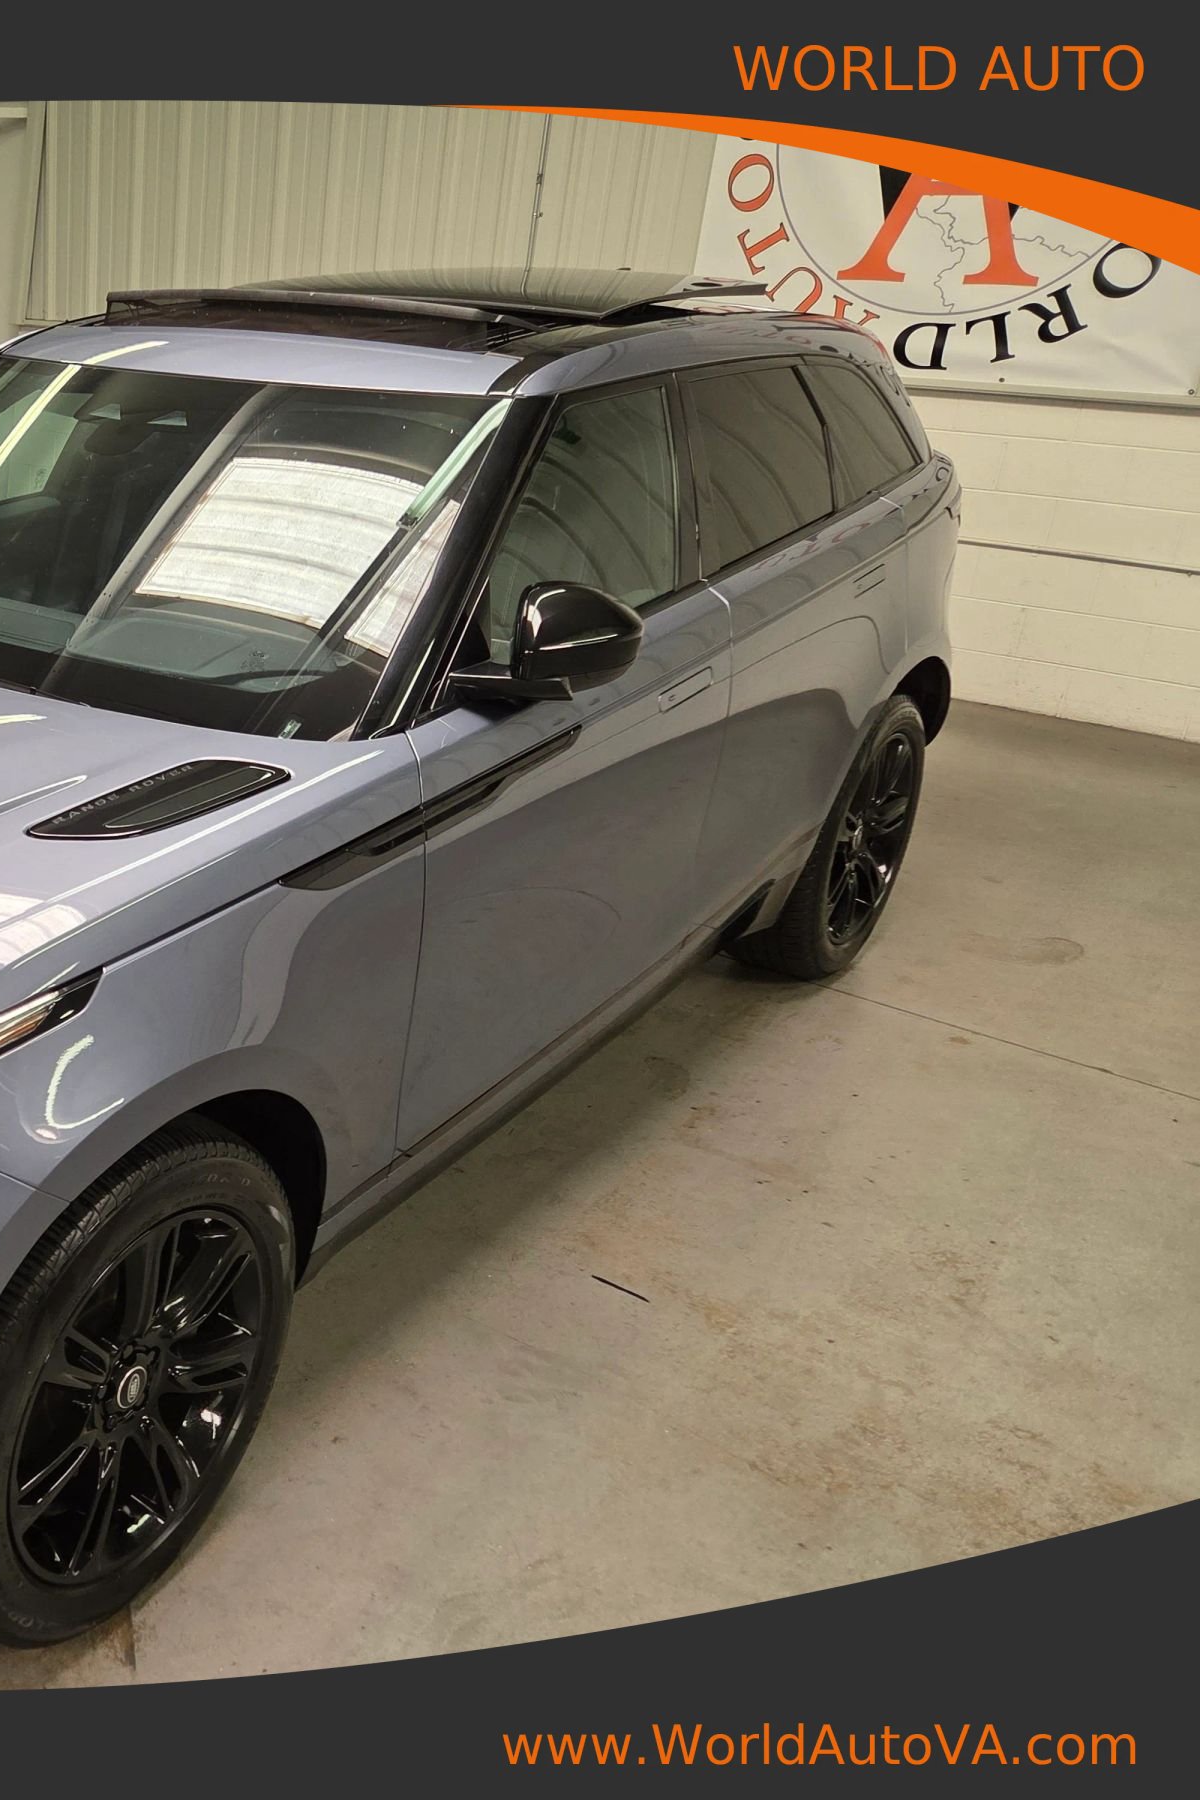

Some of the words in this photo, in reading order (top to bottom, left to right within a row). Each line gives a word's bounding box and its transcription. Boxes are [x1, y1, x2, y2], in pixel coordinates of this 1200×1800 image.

[893, 242, 1162, 371] ORLD
[51, 793, 120, 825] RANGE
[128, 764, 194, 793] ROVER
